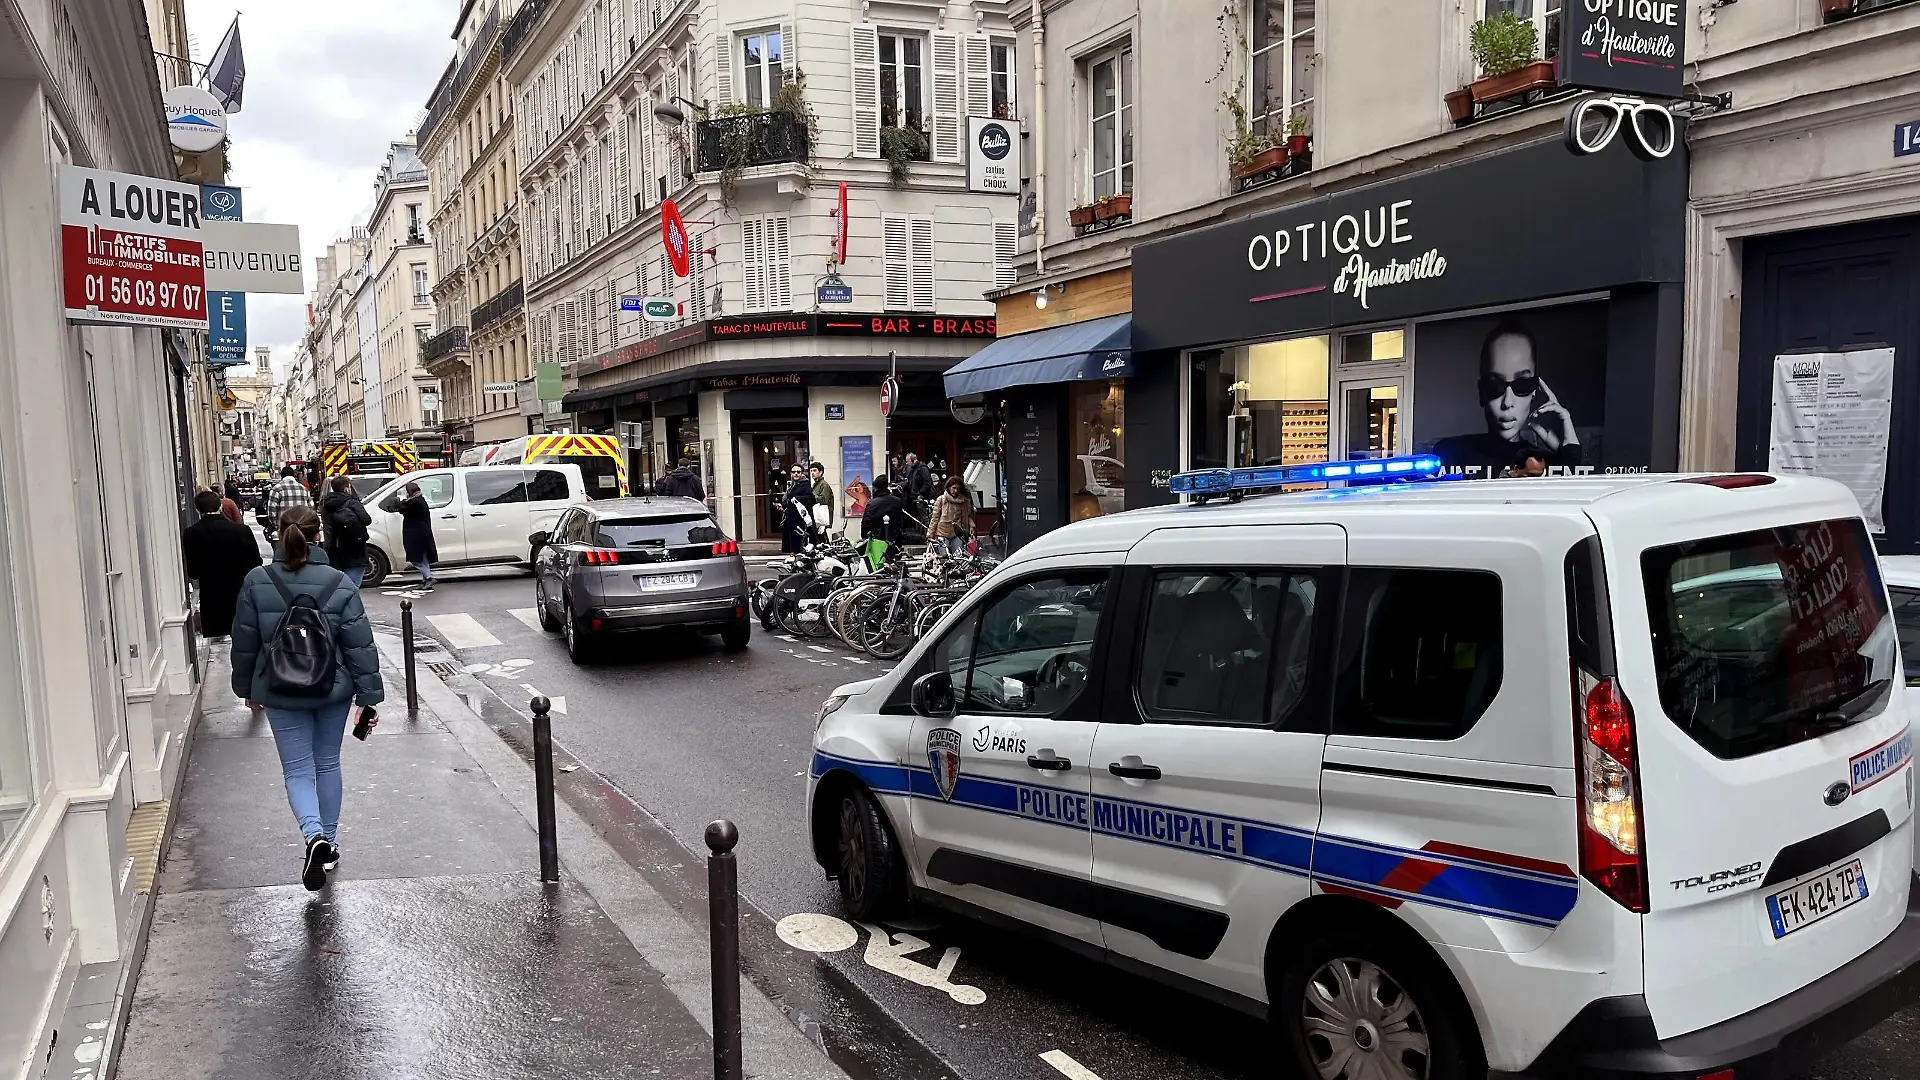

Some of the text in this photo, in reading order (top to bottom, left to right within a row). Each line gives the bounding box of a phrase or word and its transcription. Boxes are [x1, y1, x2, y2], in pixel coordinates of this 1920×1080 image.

[1581, 15, 1676, 68] d'Hauteville
[183, 104, 222, 117] Hoquet
[982, 133, 1008, 149] Bulliz
[983, 179, 1008, 189] CHOUX
[80, 177, 201, 230] A LOUER
[113, 233, 167, 251] ACTIFS
[1248, 200, 1413, 271] OPTIQUE
[87, 256, 115, 267] BUREAUX
[118, 260, 153, 271] COMMERCES
[114, 245, 201, 268] IMMOBILIER
[1333, 247, 1448, 310] d'Hauteville
[85, 274, 201, 311] 01 56 03 97 07
[100, 312, 114, 320] Nos
[115, 313, 135, 321] offres
[148, 316, 207, 328] actifsimmobilier.fr
[221, 292, 234, 331] EL
[713, 324, 742, 335] TABAC
[871, 317, 910, 333] BAR
[933, 319, 997, 334] BRASS
[212, 345, 246, 353] PROVINCES
[1102, 357, 1126, 371] Bulliz
[709, 373, 801, 388] Tabac d'Hauteville
[1438, 465, 1482, 477] AINT
[1604, 465, 1649, 475] OPTIQUE
[929, 730, 960, 746] POLICE
[992, 736, 1027, 754] PARIS
[1853, 750, 1886, 785] POLICE
[1019, 786, 1237, 854] POLICE MUNICIPALE
[1670, 861, 1762, 890] TOURNEO
[1707, 872, 1765, 894] CONNECT
